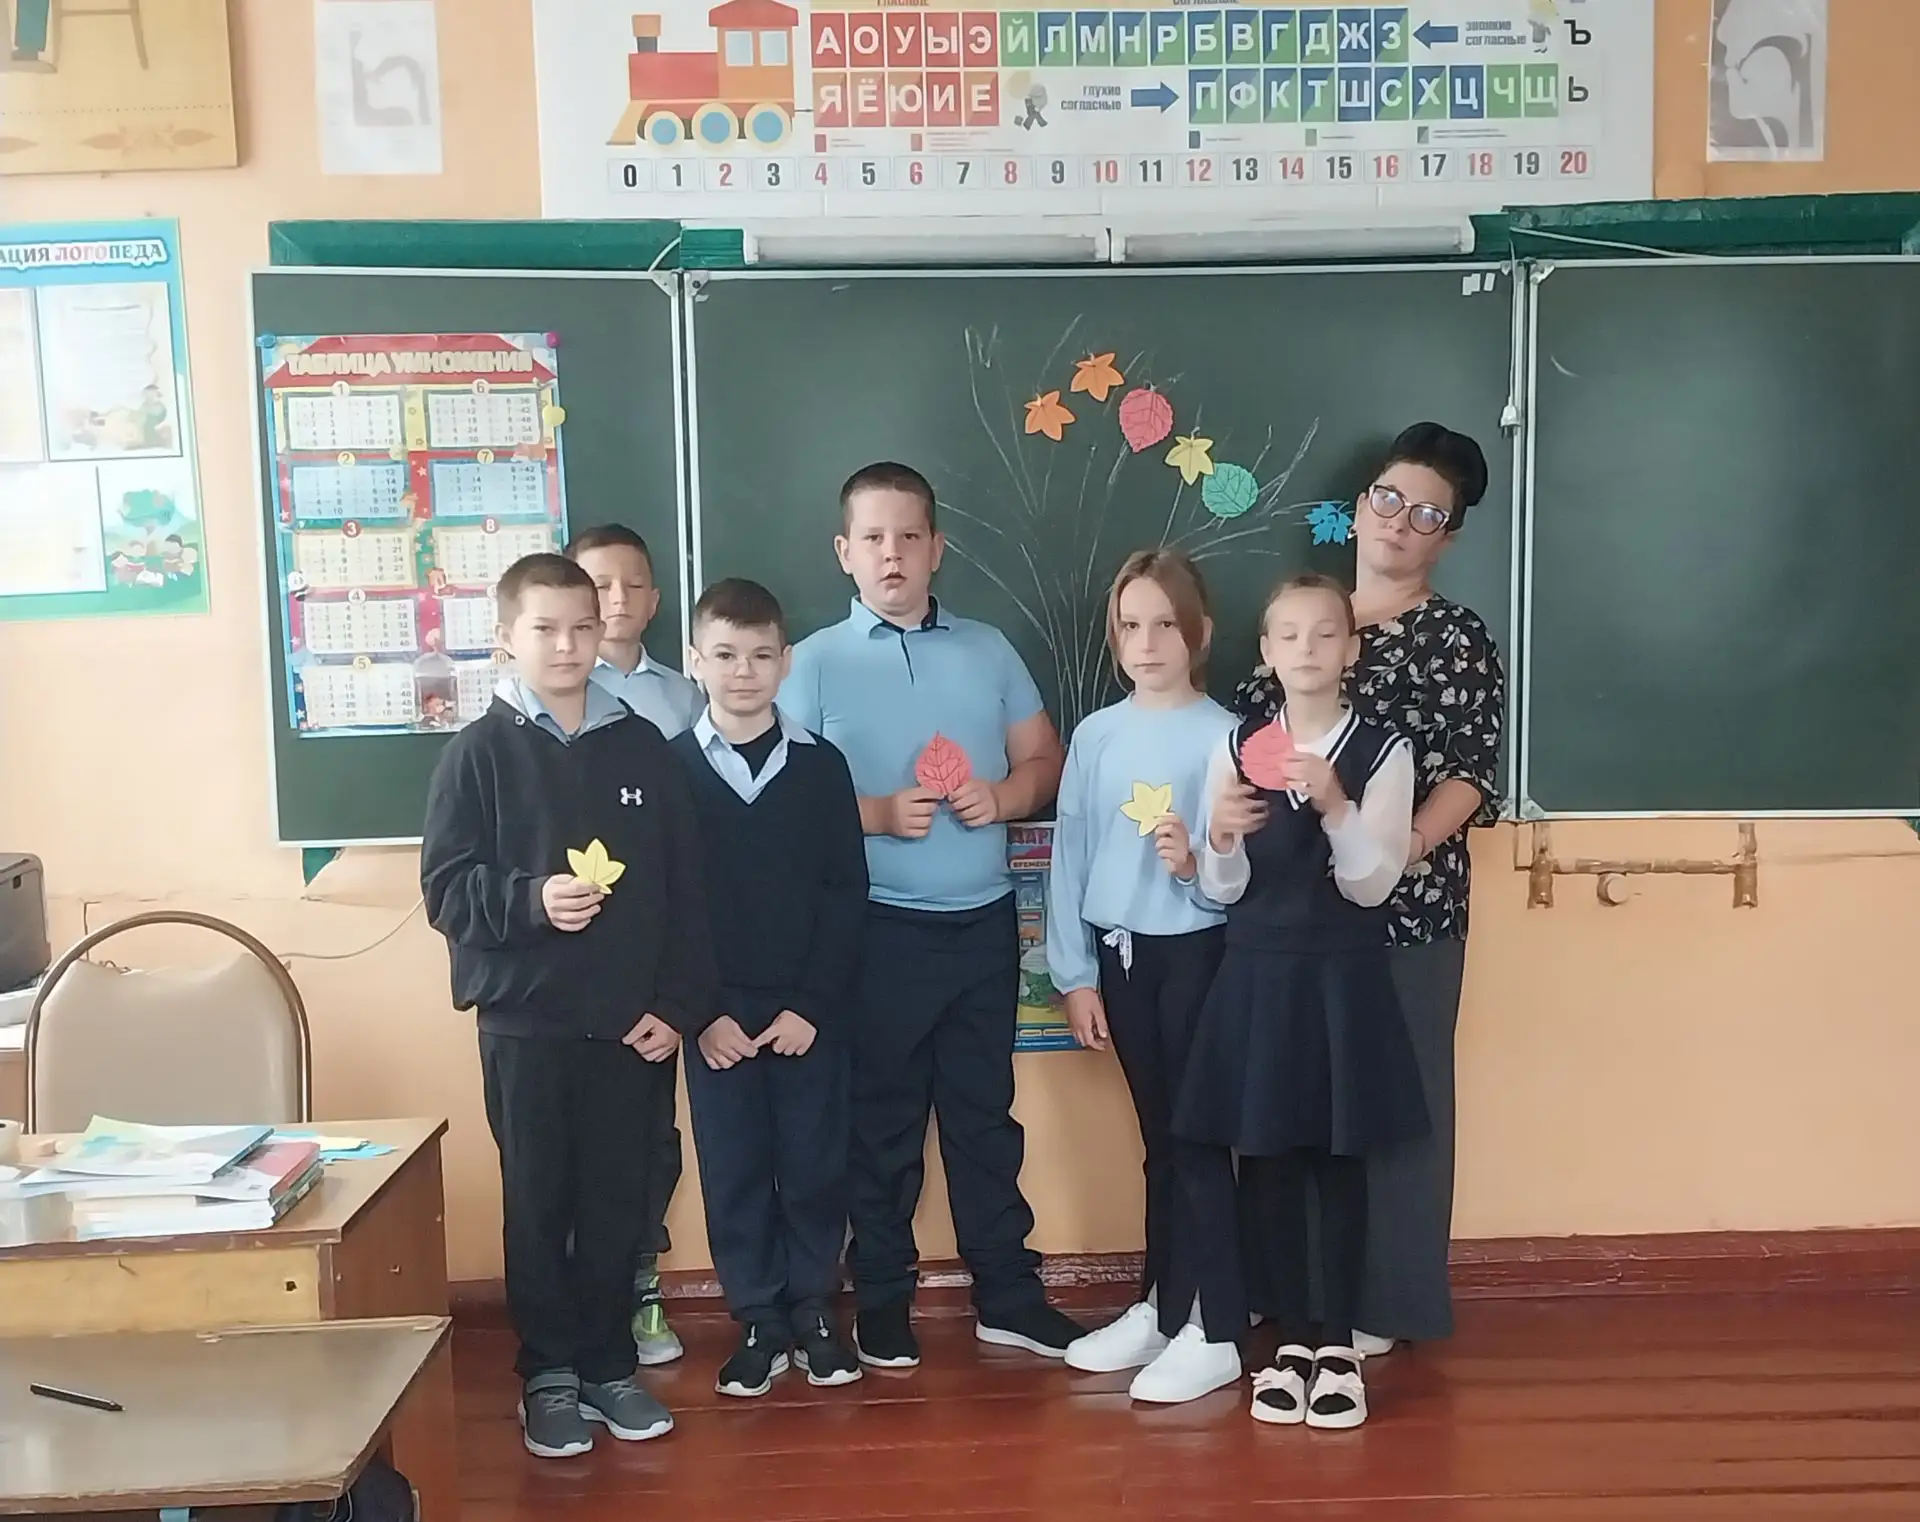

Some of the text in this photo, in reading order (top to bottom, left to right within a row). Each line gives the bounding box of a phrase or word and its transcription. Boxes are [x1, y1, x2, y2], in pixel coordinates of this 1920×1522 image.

[815, 17, 1402, 57] А О У Ы Э Й Л М Н Р Б В Г Д Ж З
[1563, 19, 1592, 45] Ъ
[819, 77, 993, 114] Я Ё Ю И Е
[1195, 75, 1557, 111] П Ф К Т Ш С Х Ц Ч Щ
[1567, 75, 1589, 103] Ь
[623, 150, 1587, 188] 0 1 2 3 4 5 6 7 8 9 10 11 12 13 14 15 16 17 18 19 20
[55, 243, 163, 262] ЛОГОПЕДА
[287, 351, 534, 377] ТАБЛИЦА УМНОЖЕНИЯ
[476, 382, 485, 393] 6
[342, 453, 351, 464] 2
[481, 451, 490, 462] 7
[346, 523, 357, 536] 3
[486, 519, 494, 531] 8
[352, 591, 360, 600] 4
[358, 658, 366, 669] 5
[494, 652, 506, 664] 10
